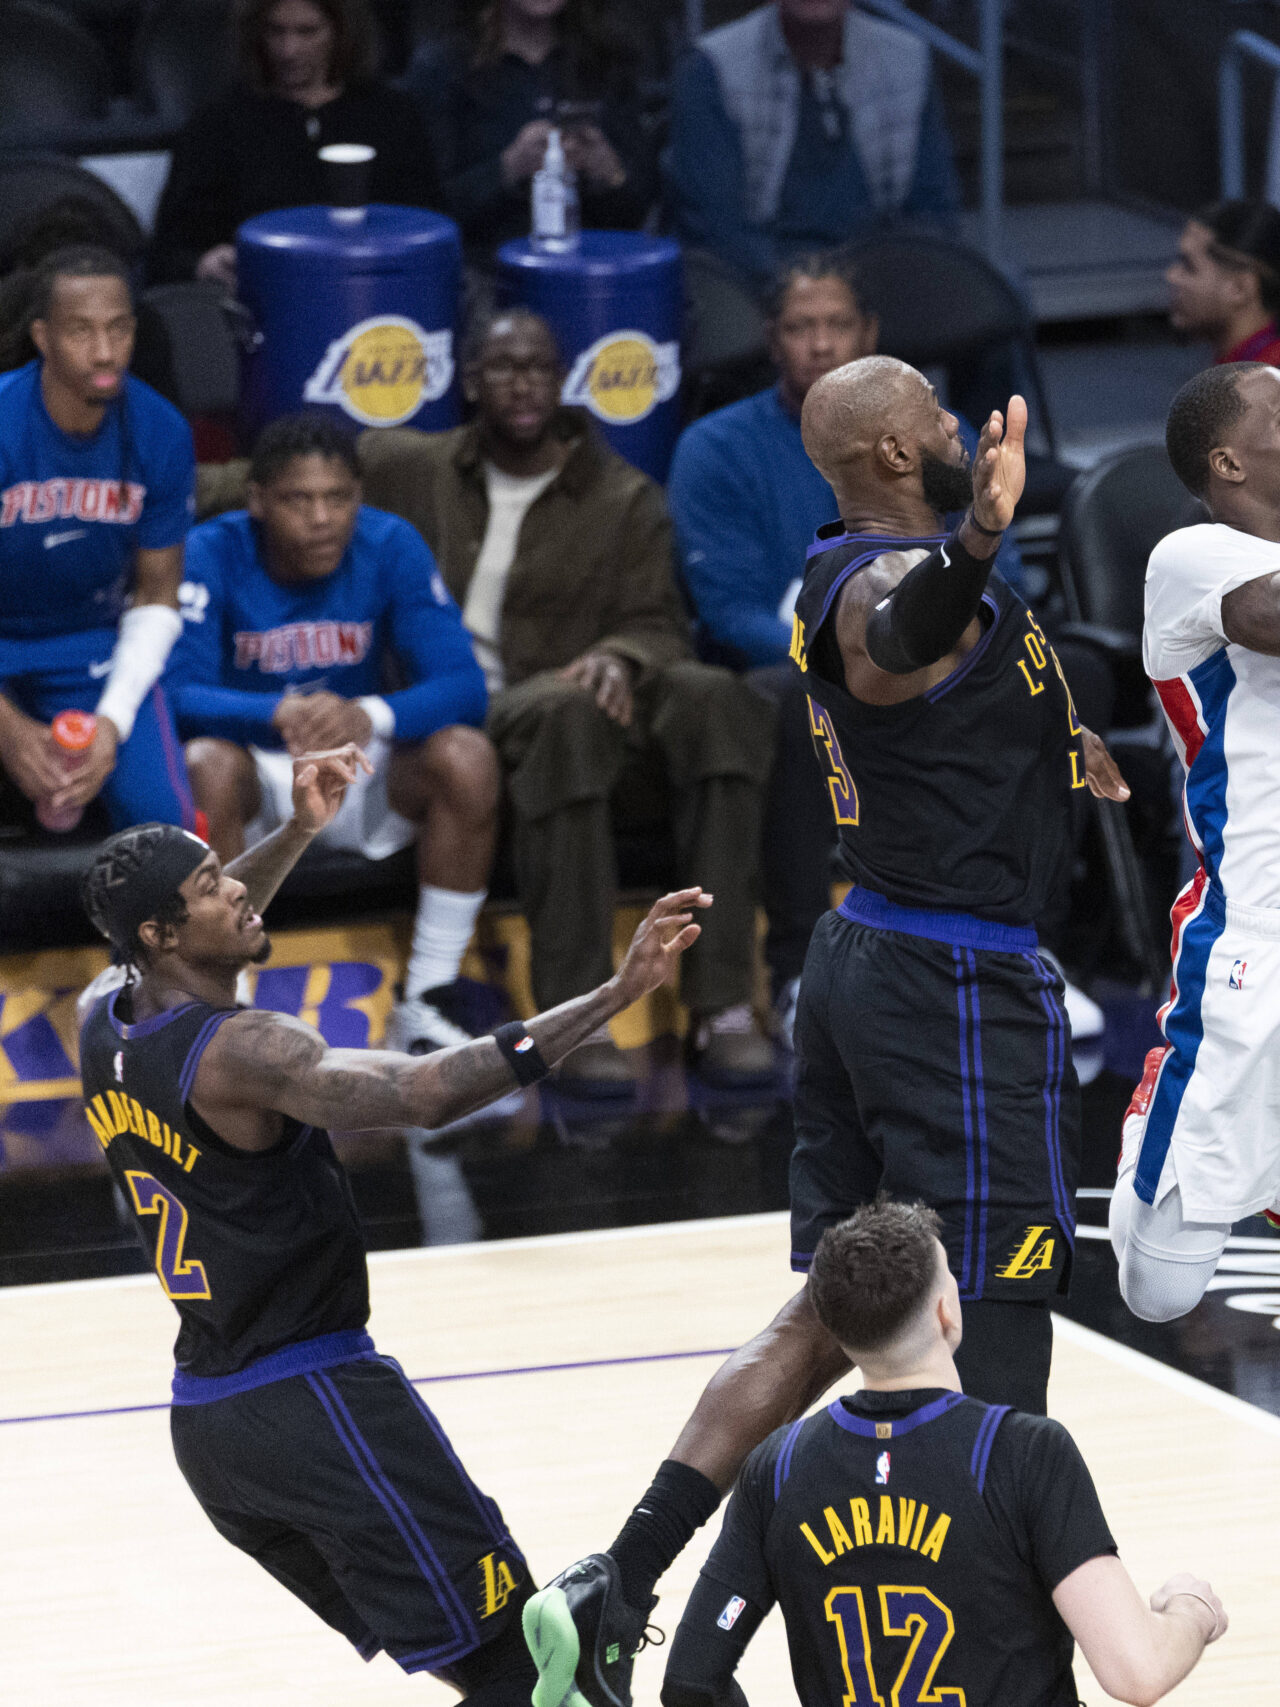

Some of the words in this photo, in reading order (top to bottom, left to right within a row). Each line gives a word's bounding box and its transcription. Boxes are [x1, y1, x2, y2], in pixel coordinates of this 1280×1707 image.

[0, 477, 147, 528] PISTONS
[85, 1089, 203, 1174] ANDERBILT
[123, 1169, 212, 1301] 2
[994, 1226, 1055, 1280] LA
[799, 1495, 952, 1567] LARAVIA
[476, 1550, 518, 1621] LA
[823, 1584, 967, 1707] 12
